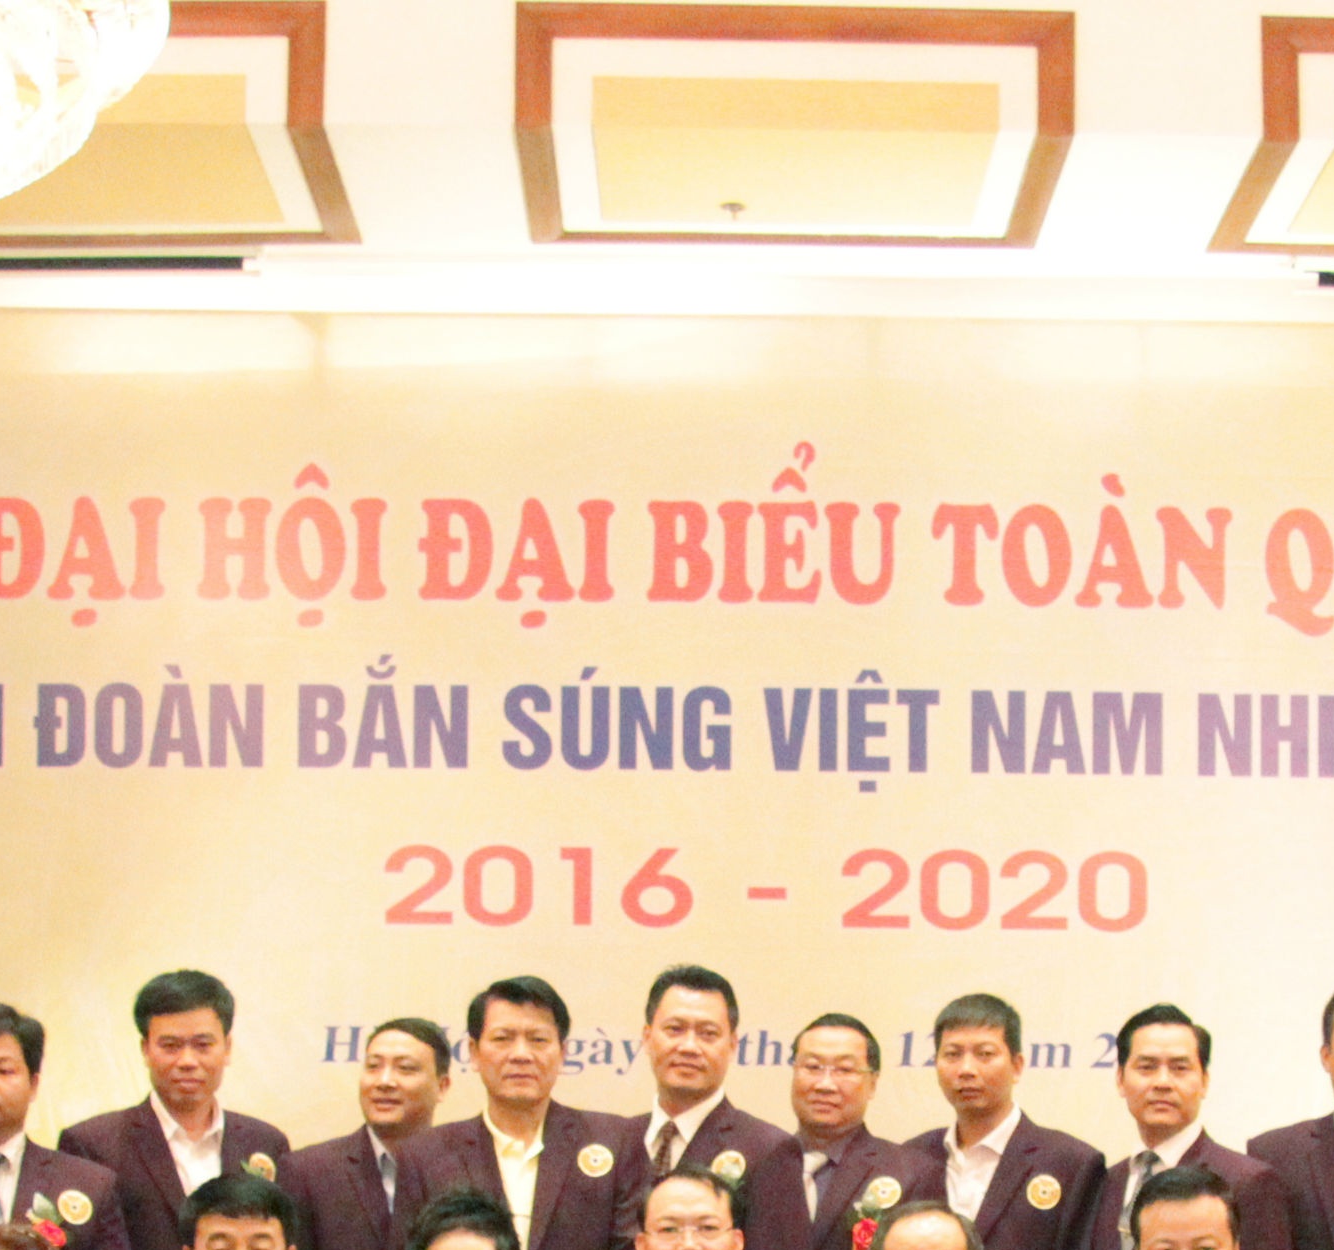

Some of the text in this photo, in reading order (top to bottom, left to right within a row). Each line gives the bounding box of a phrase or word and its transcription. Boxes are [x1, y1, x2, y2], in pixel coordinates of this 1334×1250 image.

[197, 463, 388, 628] HỘI
[419, 498, 615, 630] ĐẠI
[647, 440, 901, 607] BIỂU
[932, 473, 1232, 612] TOÀN
[34, 664, 266, 770] ĐOÀN
[297, 654, 470, 770] BẮN
[502, 666, 733, 772] SÚNG
[763, 669, 940, 794] VIỆT
[971, 689, 1162, 775] NAM
[386, 845, 694, 928] 2016
[842, 849, 1147, 931] 2020
[560, 1027, 644, 1075] gày
